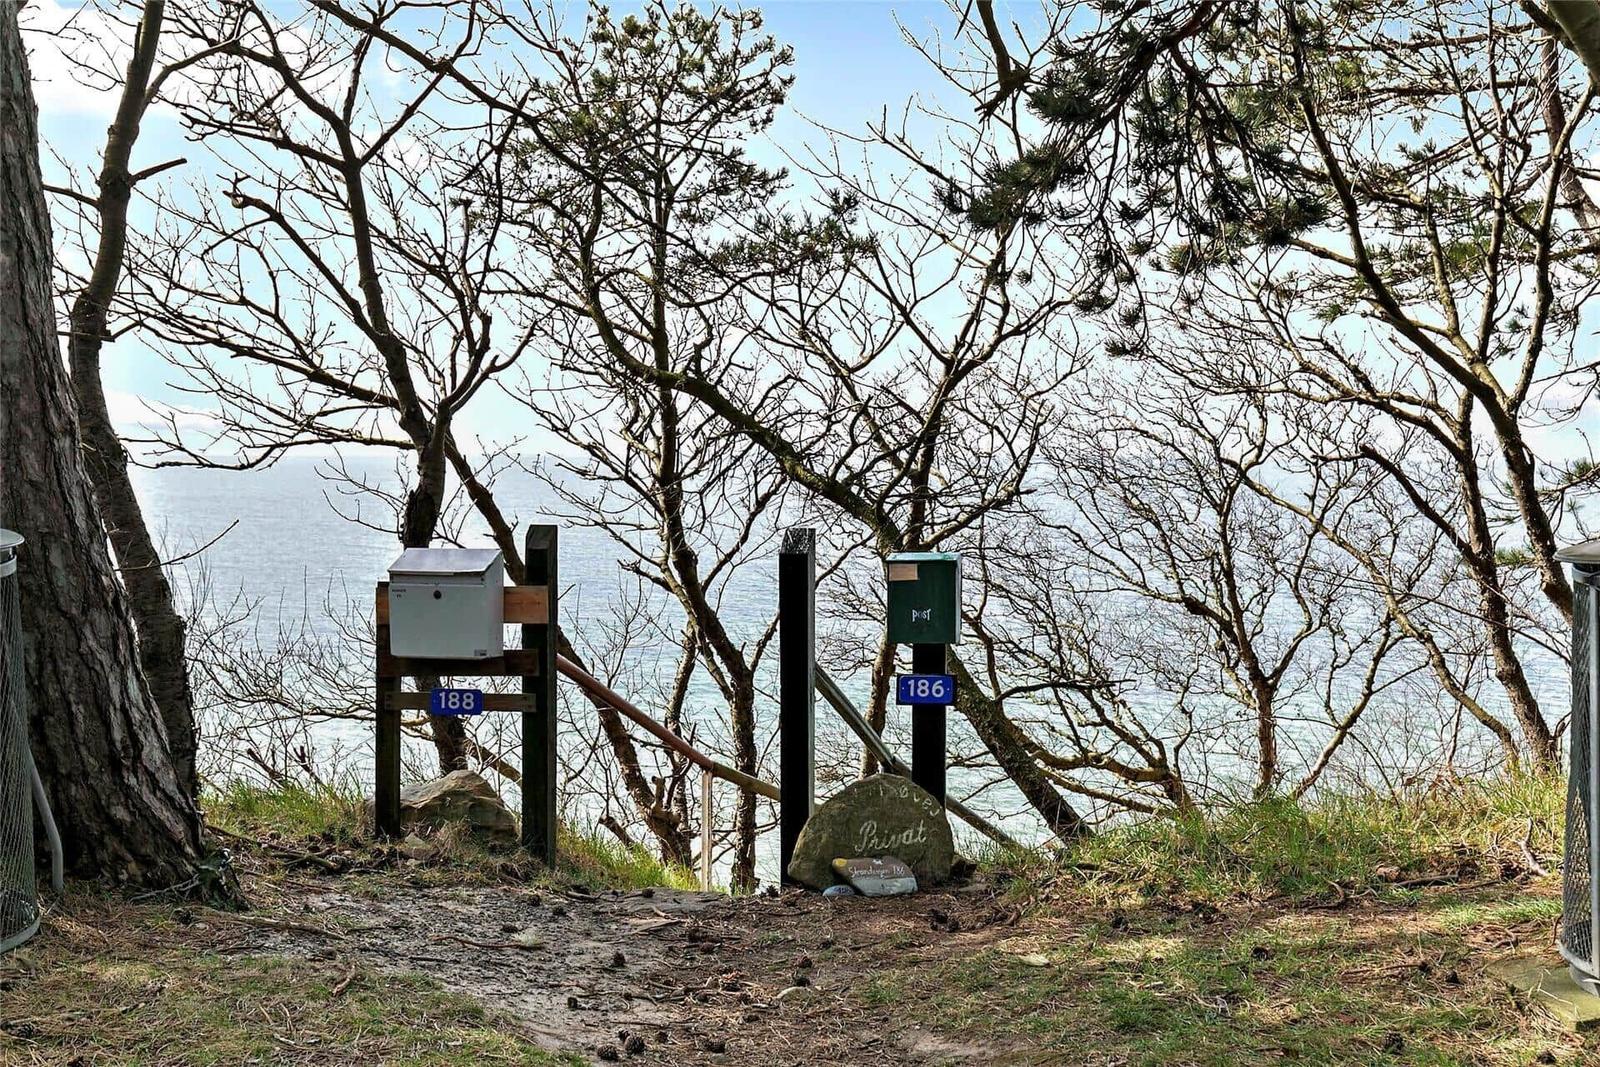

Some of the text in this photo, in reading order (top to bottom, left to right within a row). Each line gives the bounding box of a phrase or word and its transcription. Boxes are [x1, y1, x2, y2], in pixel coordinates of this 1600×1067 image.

[907, 679, 945, 698] 186
[438, 691, 475, 711] 188
[854, 820, 928, 854] Privat
